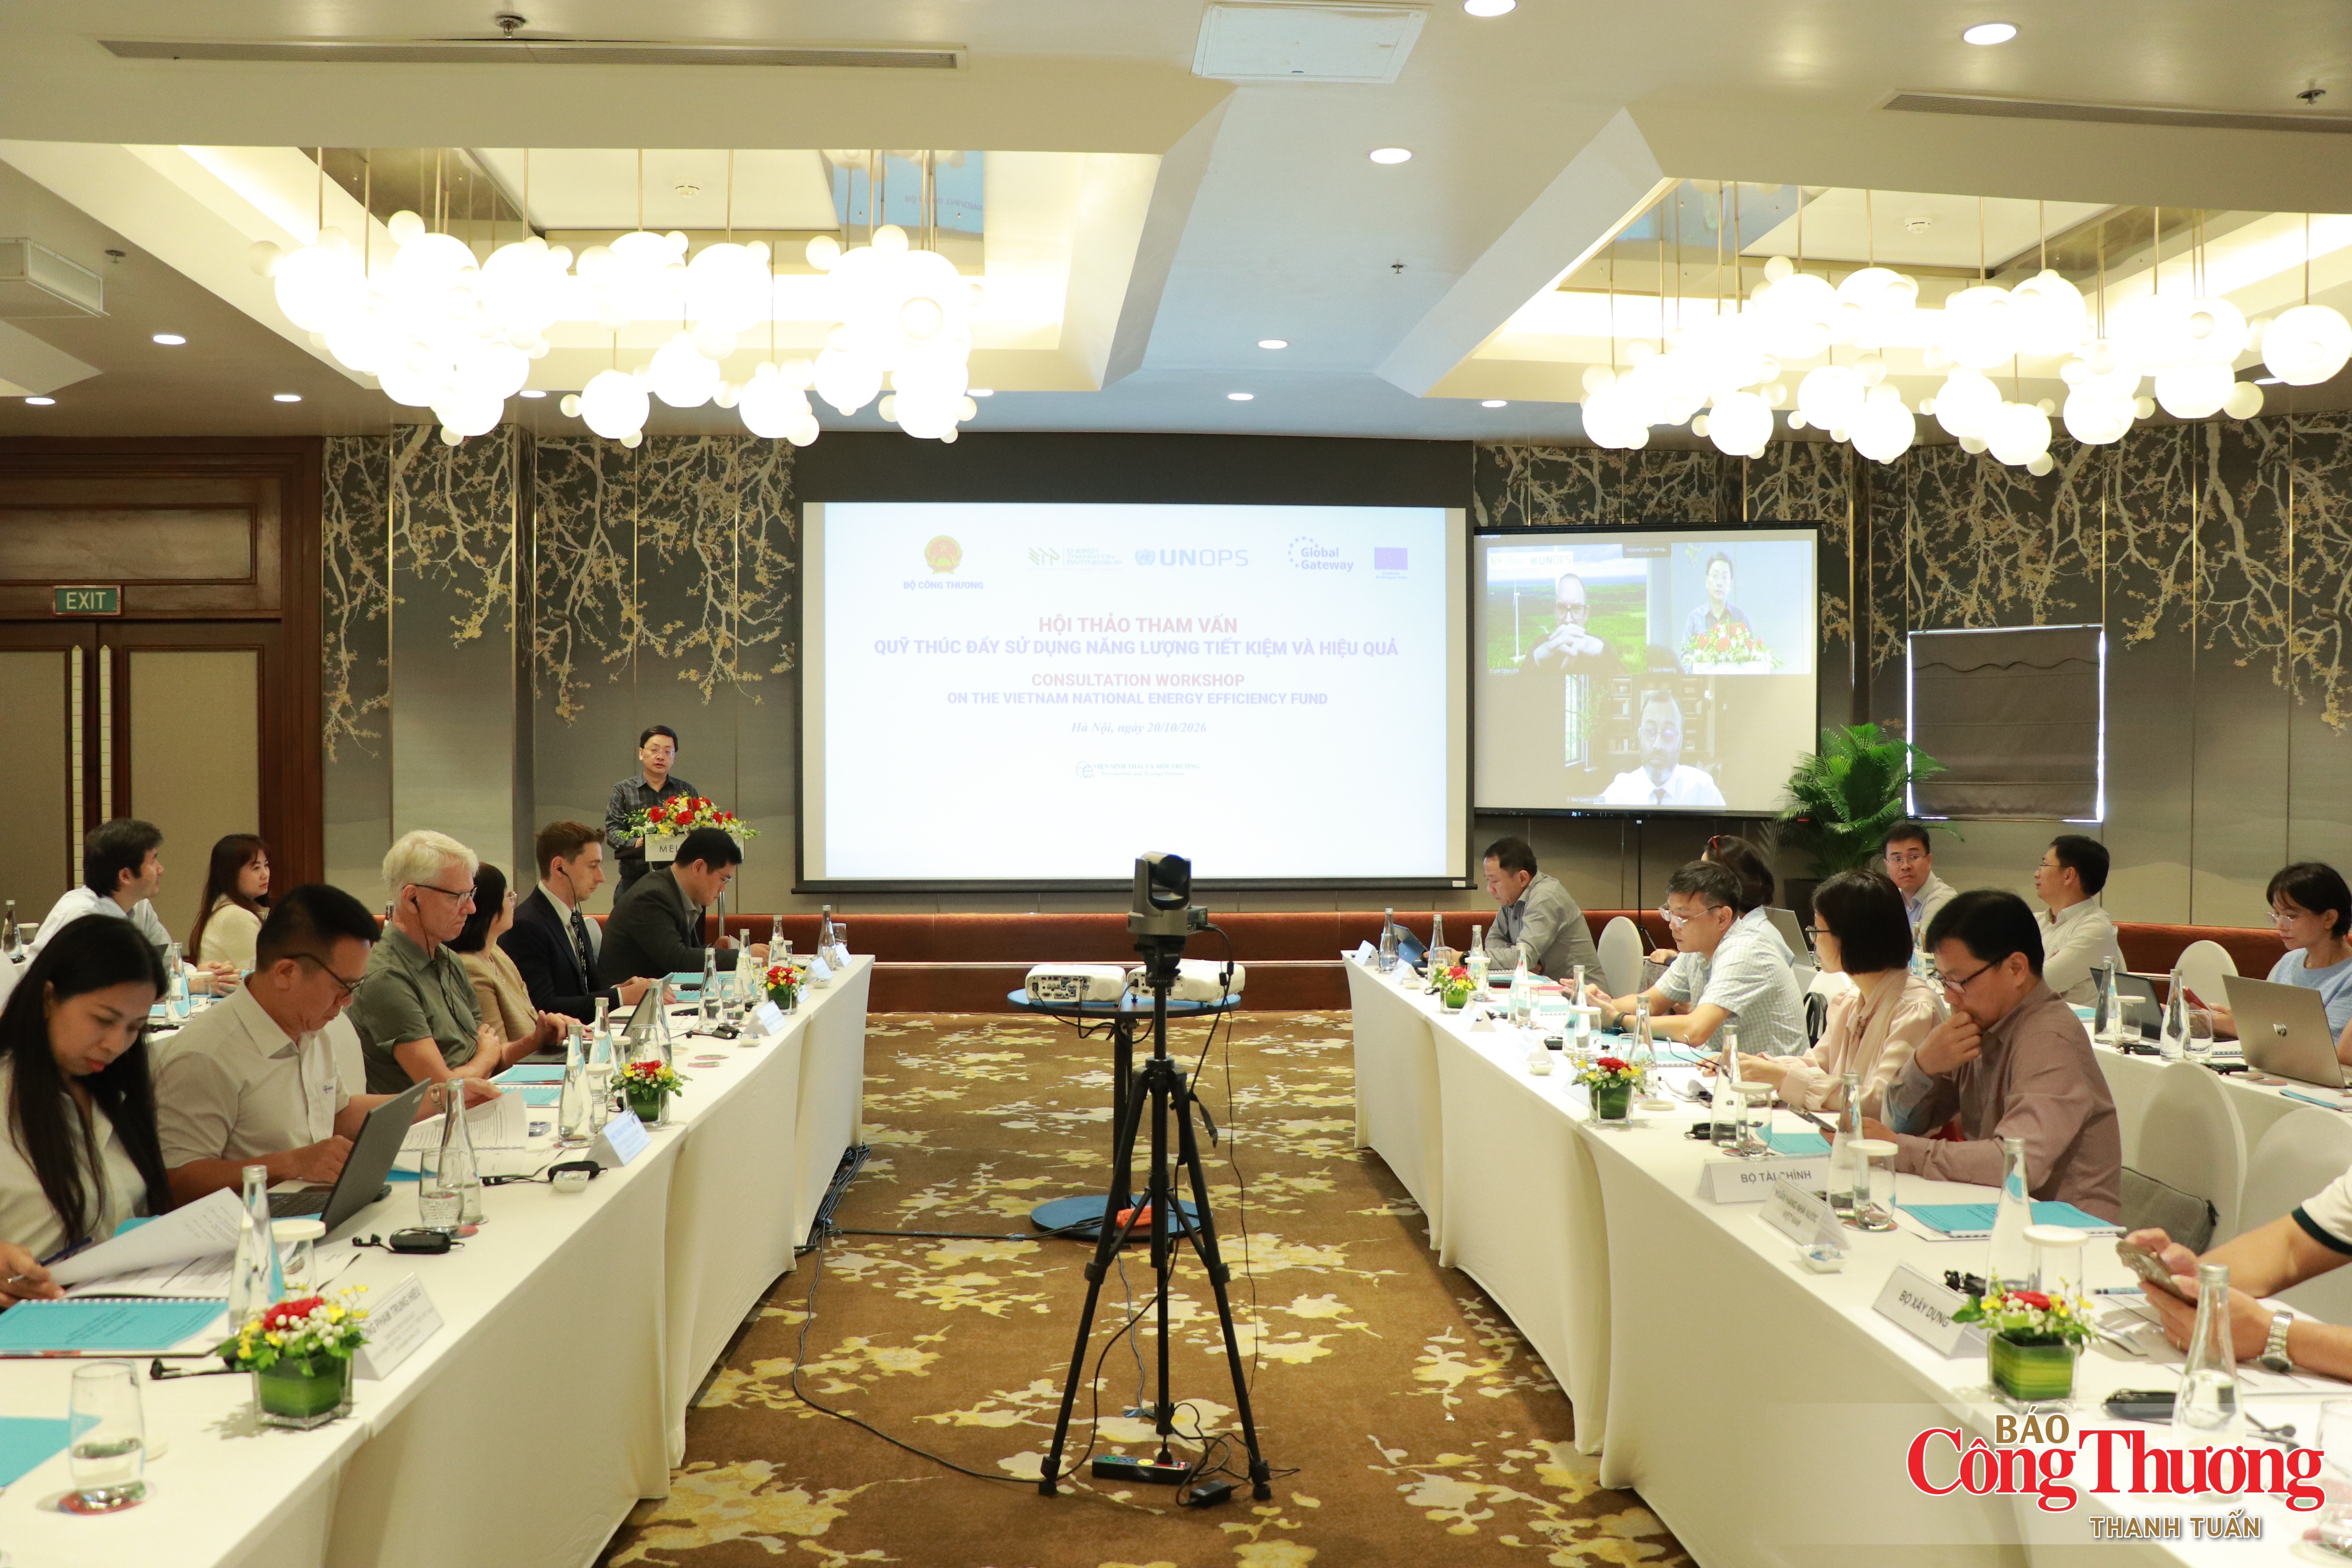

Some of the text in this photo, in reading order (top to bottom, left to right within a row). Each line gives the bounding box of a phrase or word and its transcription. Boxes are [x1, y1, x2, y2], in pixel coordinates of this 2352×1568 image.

[1160, 549, 1249, 567] UNOPS
[1301, 547, 1339, 557] Global
[1301, 559, 1354, 573] Gateway
[1539, 555, 1572, 565] UNOPS
[904, 580, 984, 591] BỘ CÔNG THƯƠNG
[66, 592, 107, 610] EXIT
[1039, 613, 1237, 635] HỘI THẢO THAM VẤN
[874, 636, 1399, 658] QUỸ THÚC ĐẨY SỬ DỤNG NĂNG LƯỢNG TIẾT KIỆM VÀ HIỆU QUẢ
[1032, 674, 1245, 687] CONSULTATION WORKSHOP
[947, 692, 1328, 705] ON THE VIETNAM NATIONAL ENERGY EFFICIENCY FUND
[1071, 722, 1207, 735] Hà Nội, ngày 20/10/2026
[1740, 1172, 1756, 1184] BỘ
[1759, 1170, 1776, 1181] TÀI
